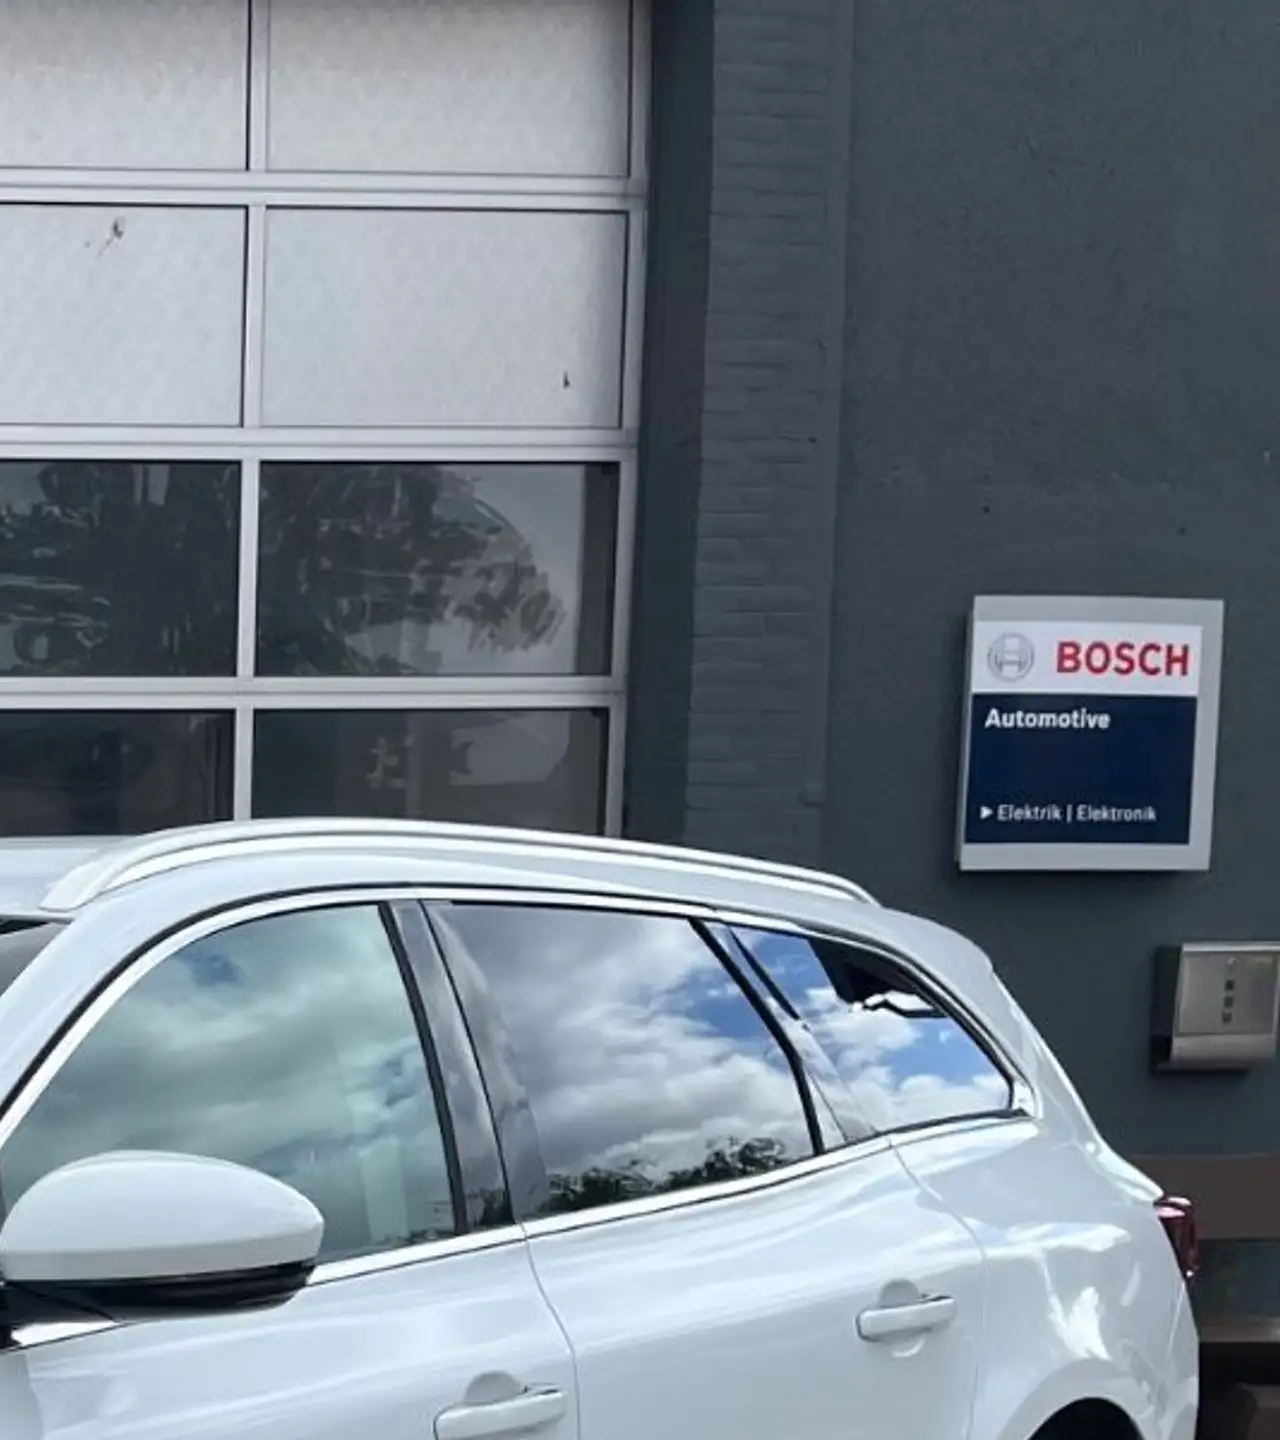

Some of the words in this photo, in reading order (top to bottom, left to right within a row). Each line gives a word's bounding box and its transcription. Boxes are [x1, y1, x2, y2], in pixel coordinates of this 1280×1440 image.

[1055, 640, 1191, 677] BOSCH
[984, 707, 1112, 730] Automotive
[996, 803, 1063, 822] Elektrik
[1075, 803, 1157, 822] Elektronik
